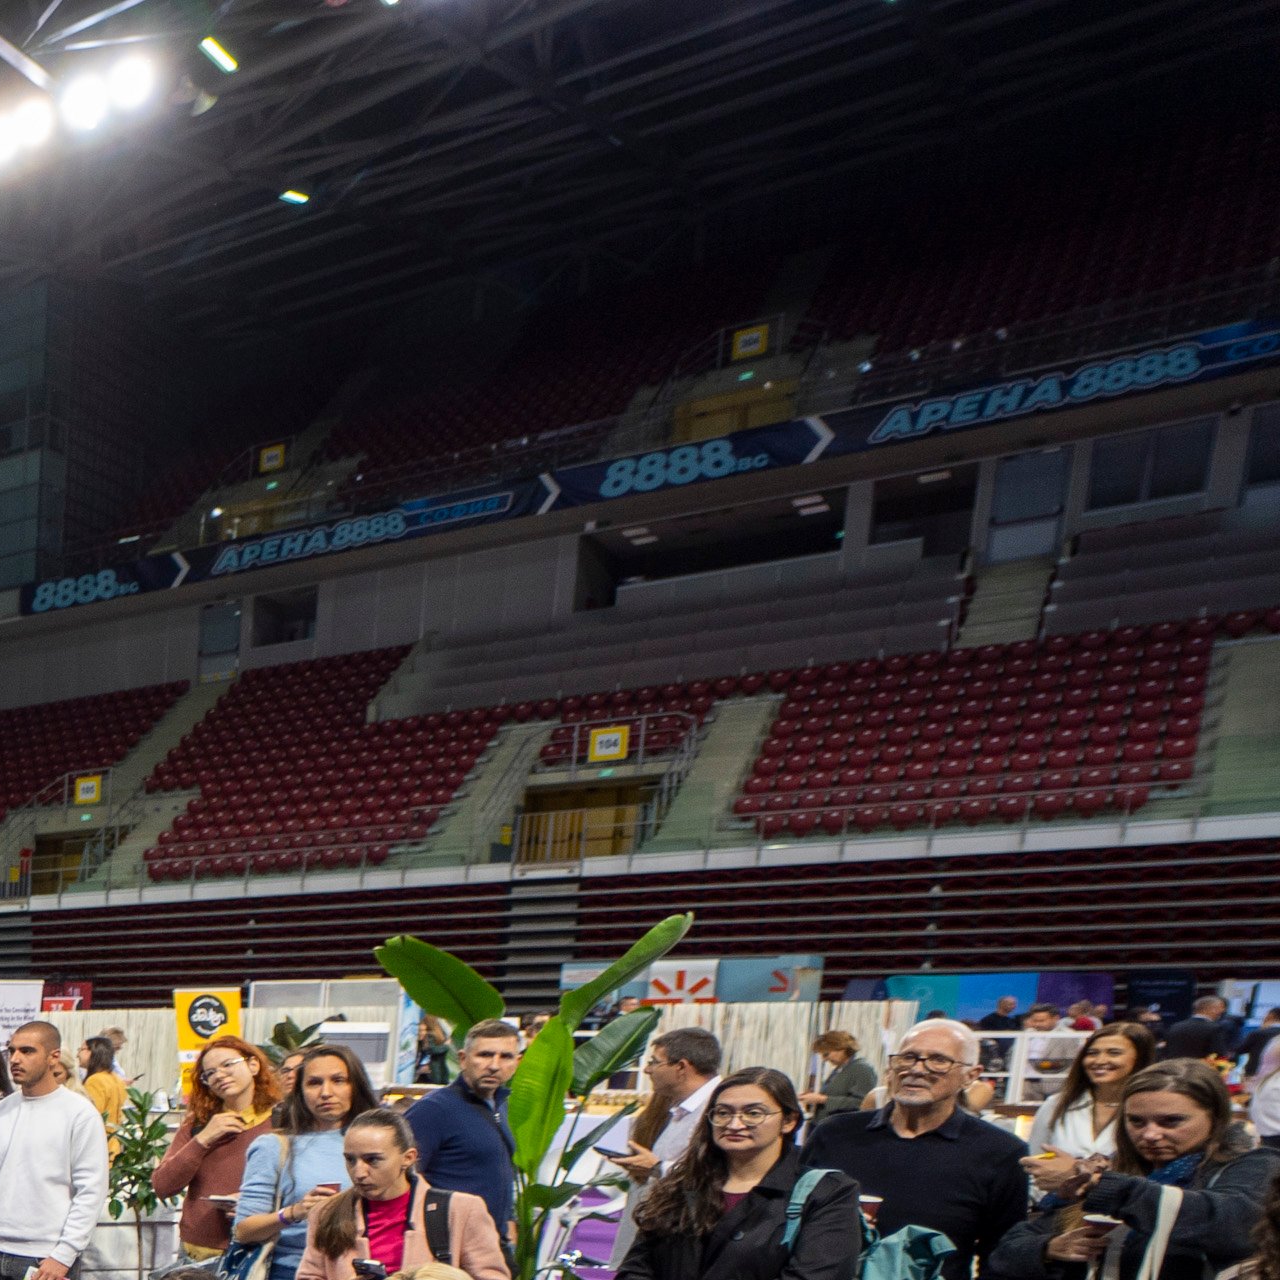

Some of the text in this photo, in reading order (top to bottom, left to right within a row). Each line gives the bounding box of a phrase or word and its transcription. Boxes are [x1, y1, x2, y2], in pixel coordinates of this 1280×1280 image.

[872, 375, 1063, 442] АРЕНА
[1068, 345, 1202, 400] 8888
[216, 529, 328, 572] АРЕНА
[330, 511, 407, 548] 8888
